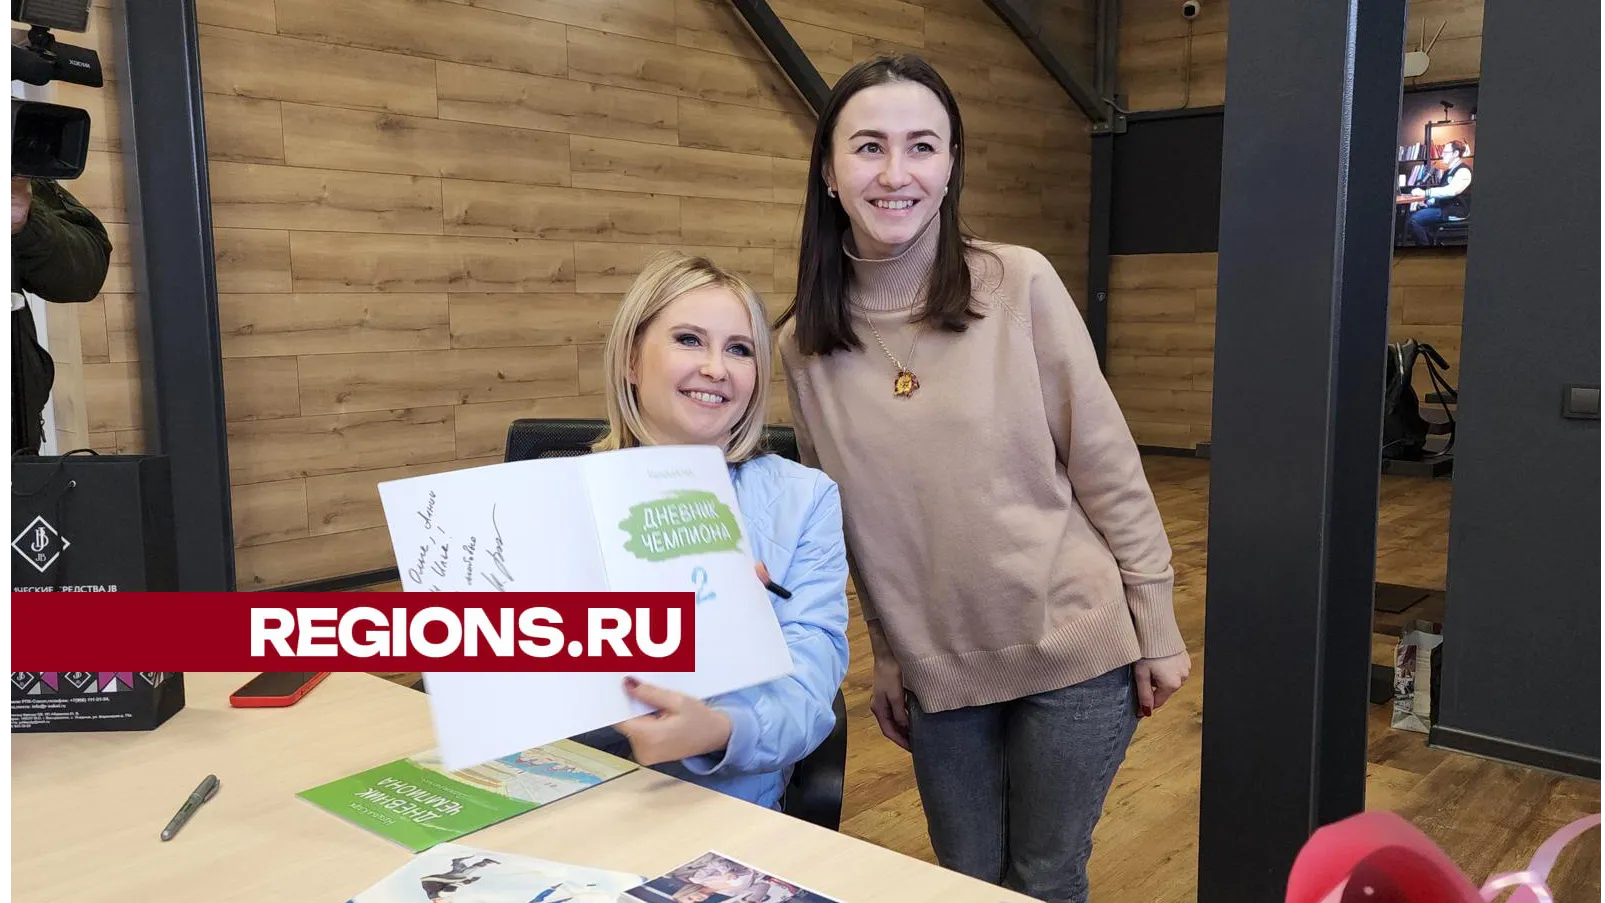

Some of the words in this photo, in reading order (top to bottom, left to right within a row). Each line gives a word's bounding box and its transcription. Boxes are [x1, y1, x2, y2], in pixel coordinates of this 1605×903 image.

[642, 499, 719, 531] ДНЕВНИК
[641, 522, 732, 554] ЧЕМПИОНА
[691, 566, 717, 605] 2
[354, 787, 442, 822] ДНЕВНИК
[377, 776, 464, 815] ЧЕМПИОНА
